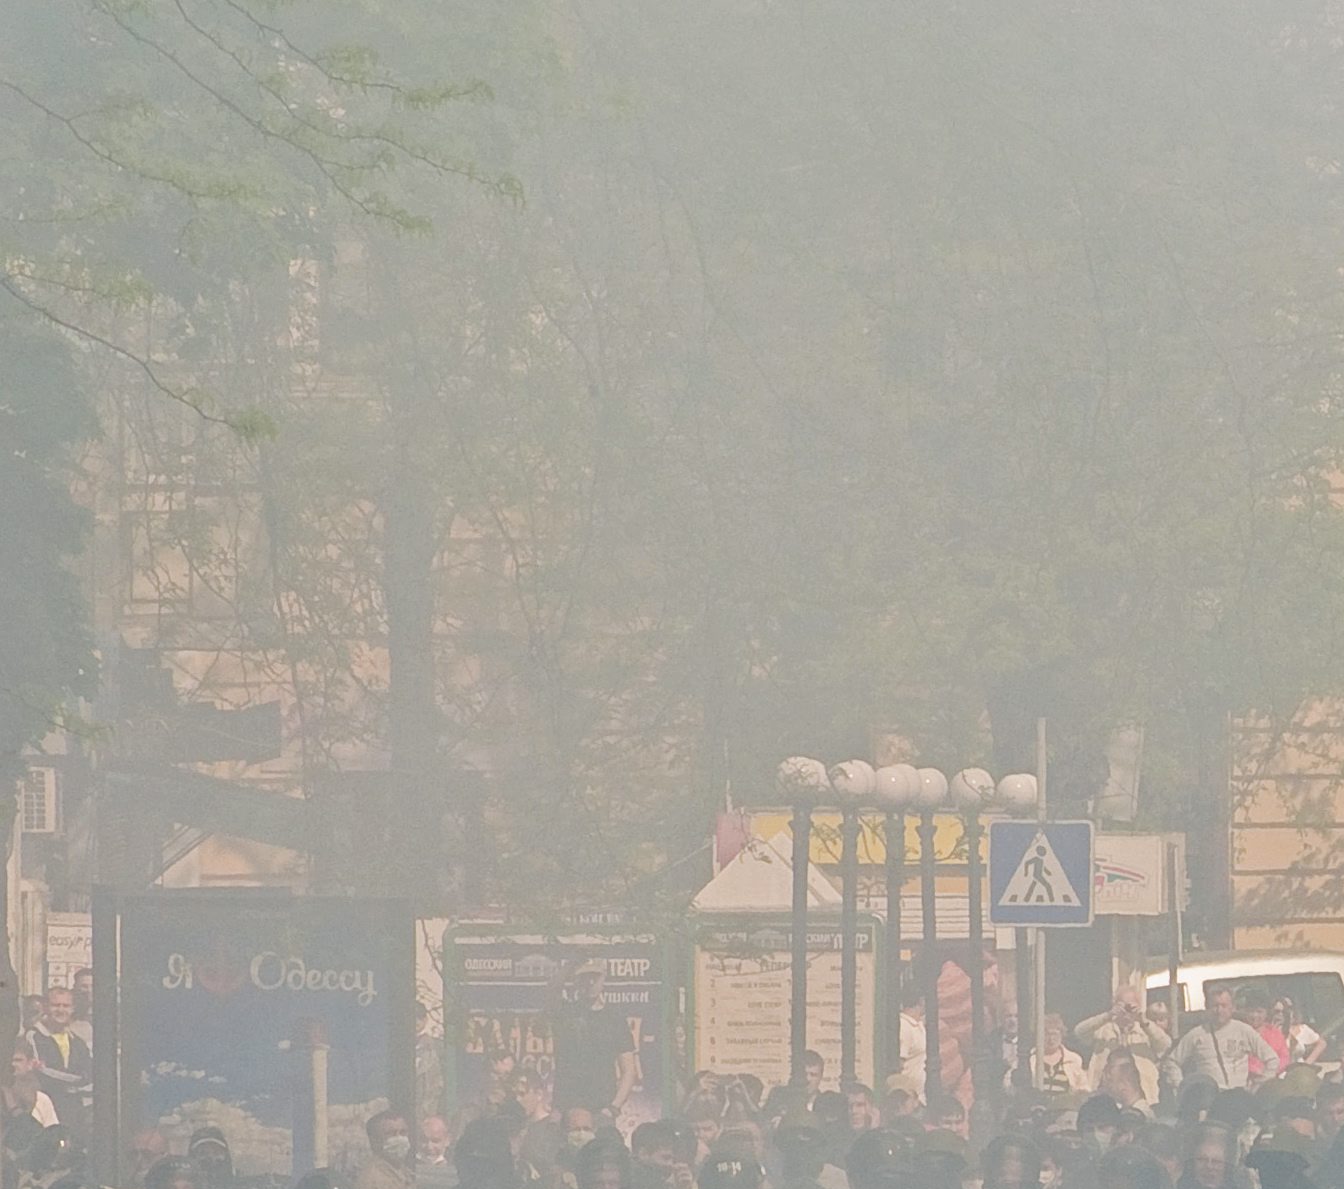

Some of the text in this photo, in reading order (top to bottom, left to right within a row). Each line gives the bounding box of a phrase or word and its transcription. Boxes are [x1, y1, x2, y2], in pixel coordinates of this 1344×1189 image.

[162, 951, 378, 1006] Я Одессу
[609, 957, 651, 977] ТЕАТР
